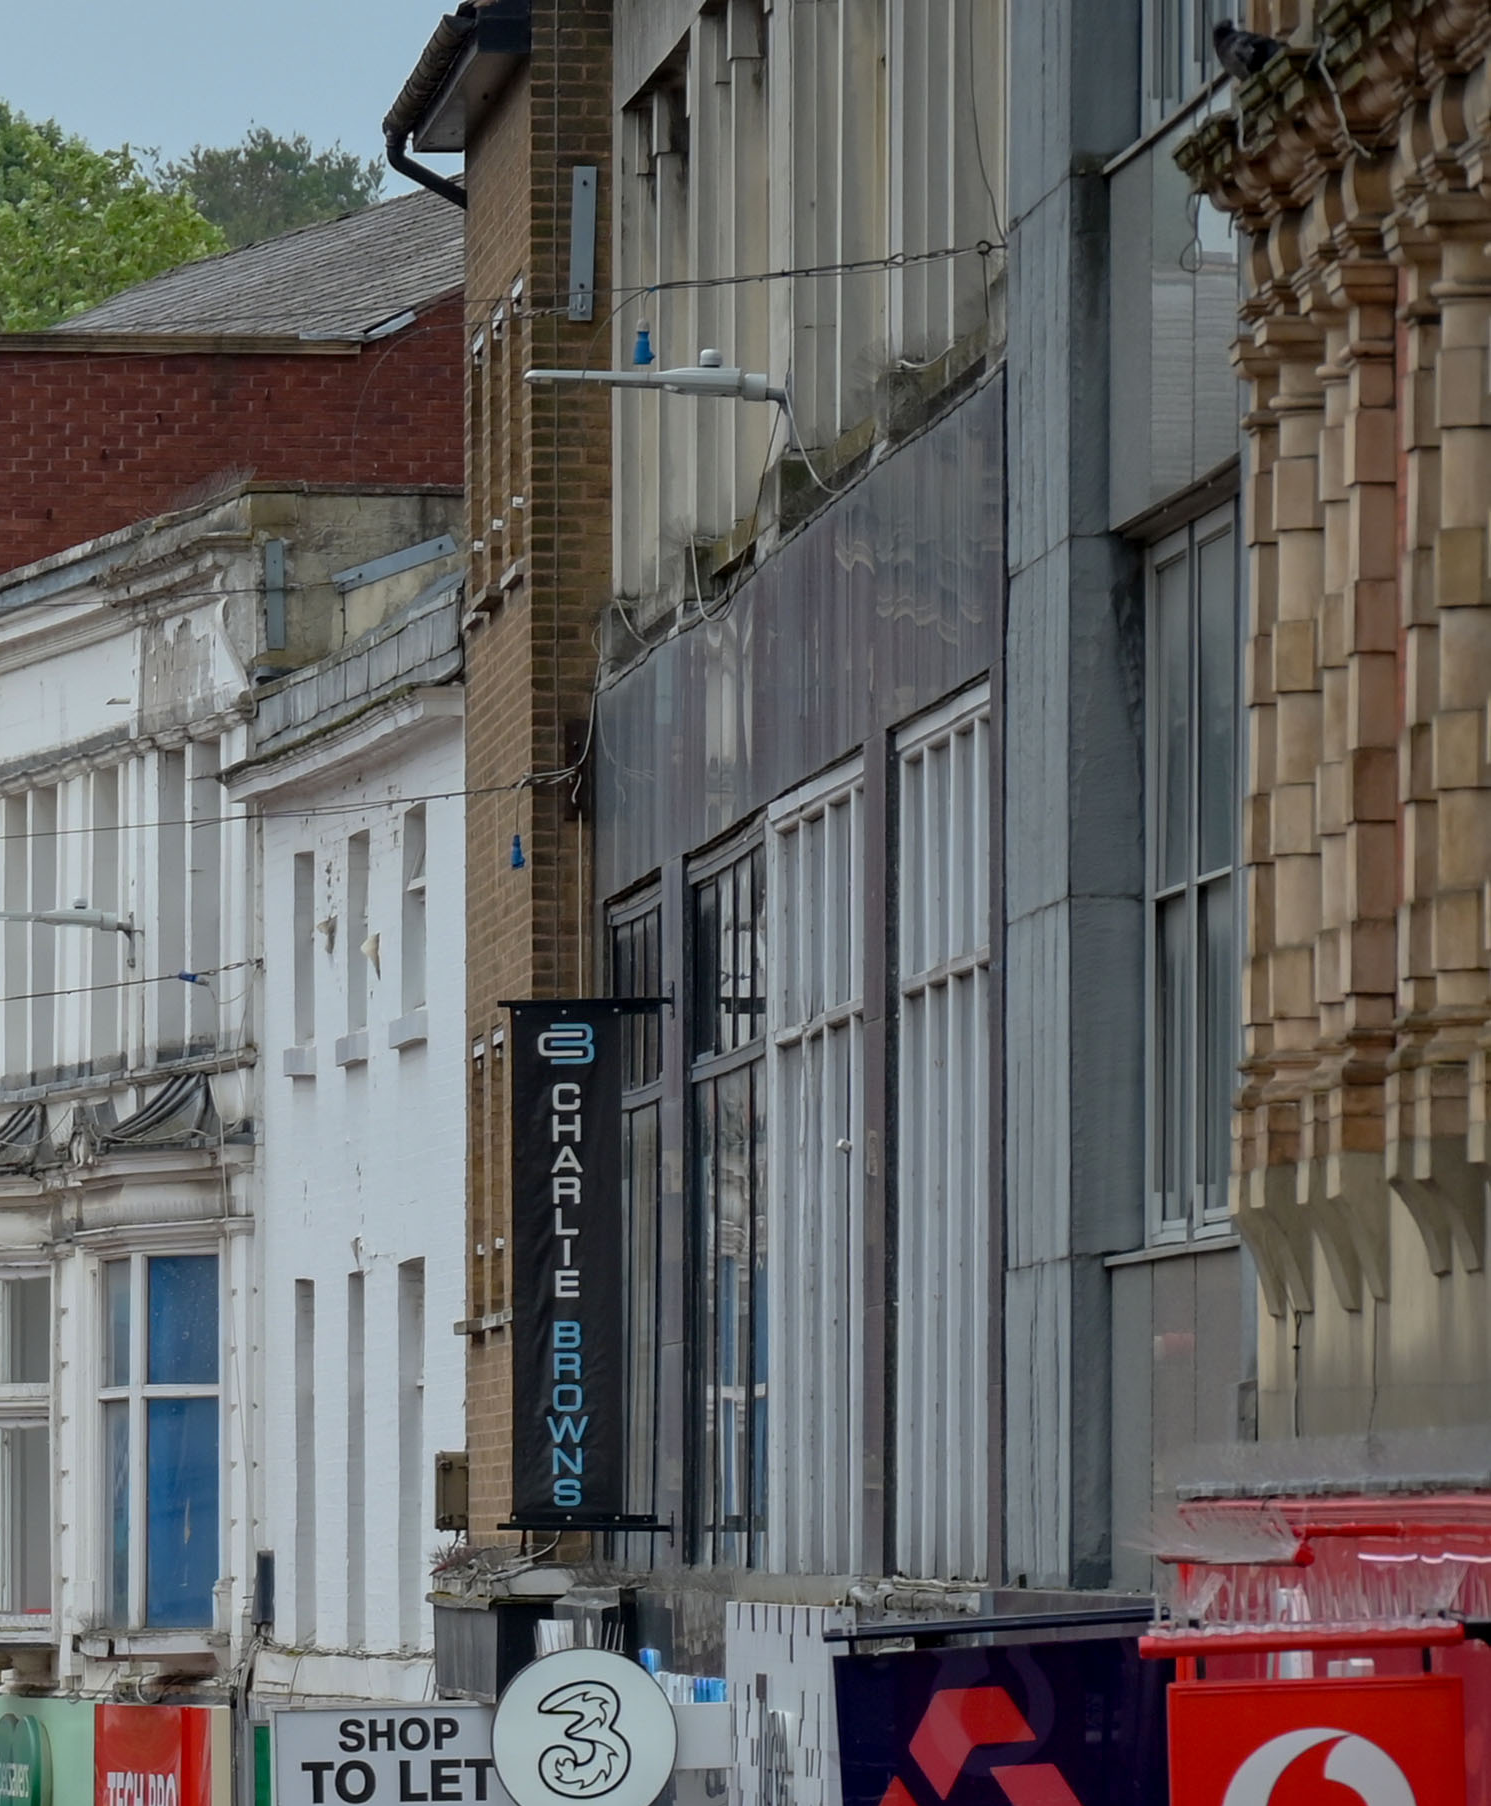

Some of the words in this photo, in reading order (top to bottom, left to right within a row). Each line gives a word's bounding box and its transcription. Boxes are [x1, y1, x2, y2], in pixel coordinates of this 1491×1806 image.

[551, 1082, 584, 1298] CHARLIE
[546, 1321, 588, 1507] BROWNS
[301, 1760, 376, 1804] TO
[399, 1758, 495, 1802] LET
[338, 1717, 459, 1752] SHOP
